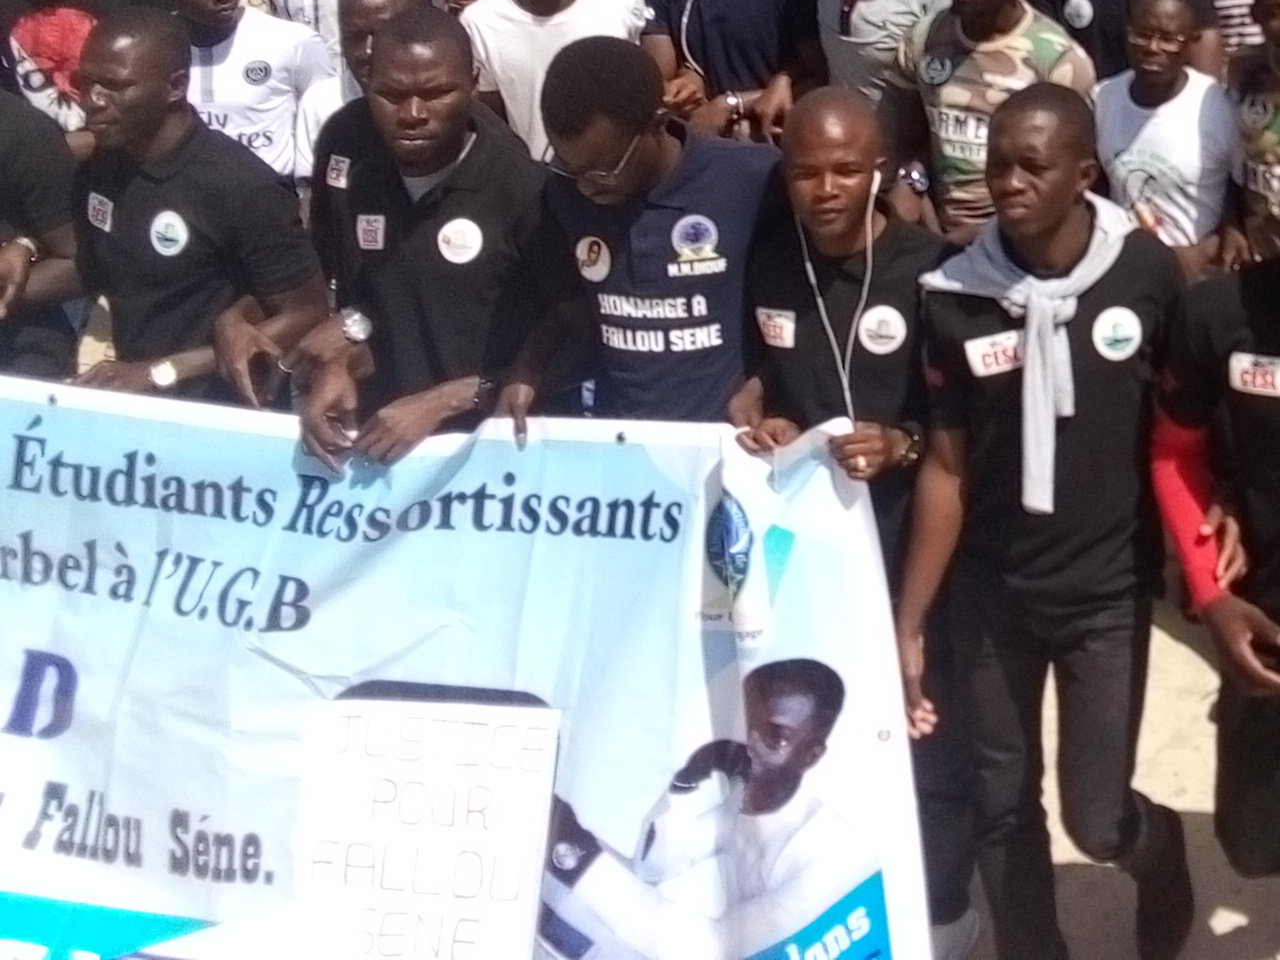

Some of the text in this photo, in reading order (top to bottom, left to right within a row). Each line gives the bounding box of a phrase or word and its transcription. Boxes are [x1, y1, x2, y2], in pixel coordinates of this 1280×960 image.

[597, 292, 708, 319] HOMMAGE A
[600, 323, 724, 352] FALLOU SENE
[6, 414, 683, 543] Étudiants Ressortissants
[108, 541, 137, 603] à
[1, 648, 78, 740] D
[338, 714, 549, 773] JUSTICE
[21, 779, 275, 886] Fallou Séne.
[371, 777, 493, 831] POUR
[310, 840, 525, 902] FALLOU
